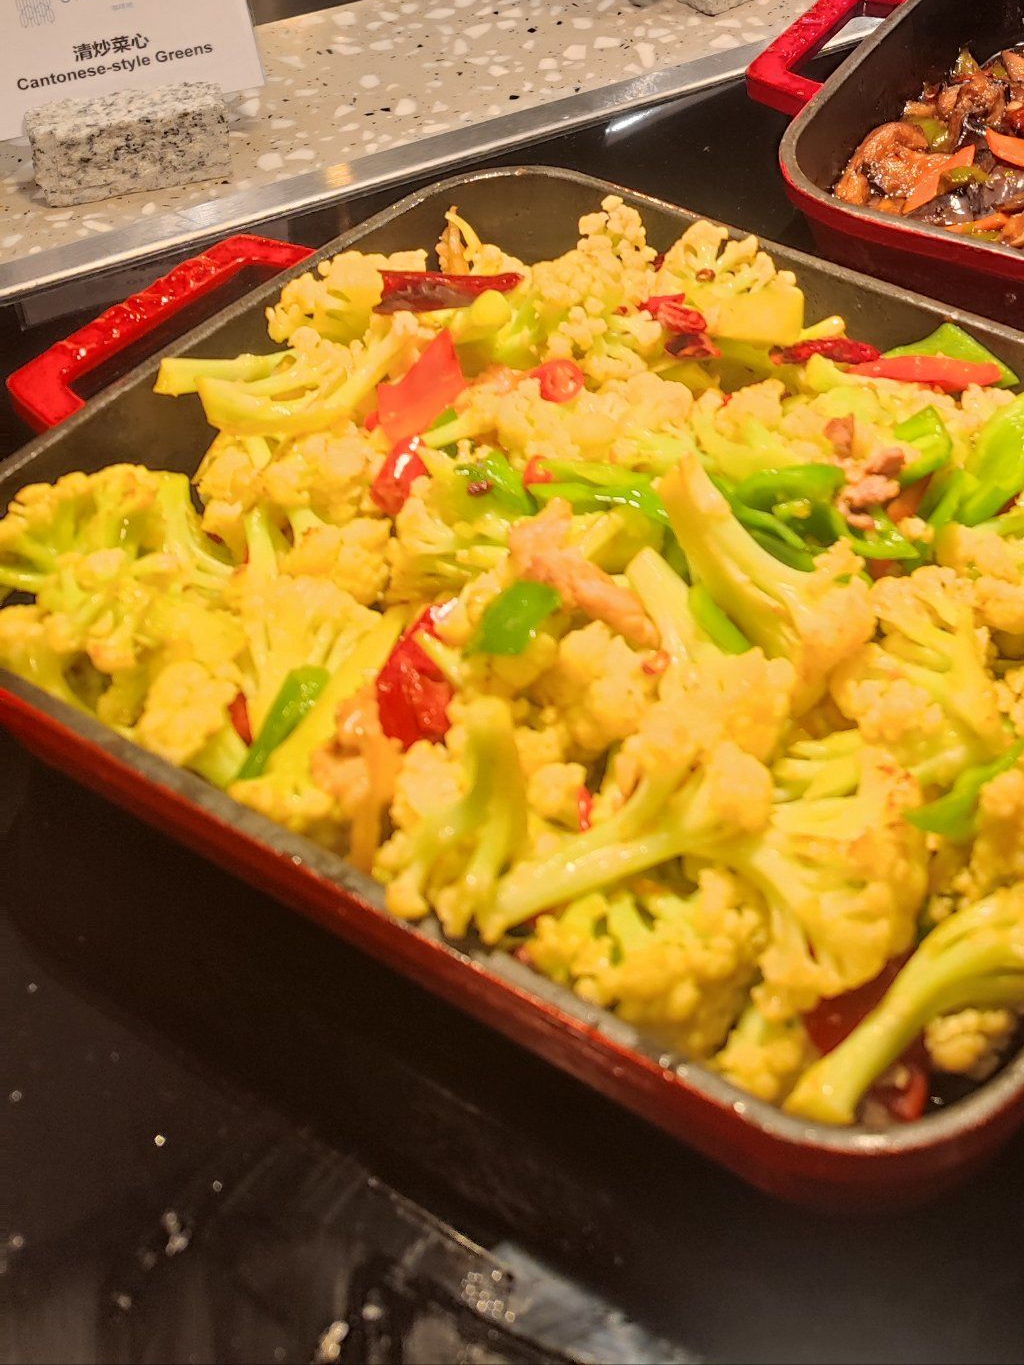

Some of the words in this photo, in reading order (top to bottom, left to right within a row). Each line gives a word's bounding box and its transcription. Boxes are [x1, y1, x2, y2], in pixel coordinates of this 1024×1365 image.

[17, 54, 151, 90] Cantonese-style
[155, 43, 213, 63] Greens
[72, 33, 150, 62] 清炒菜心
